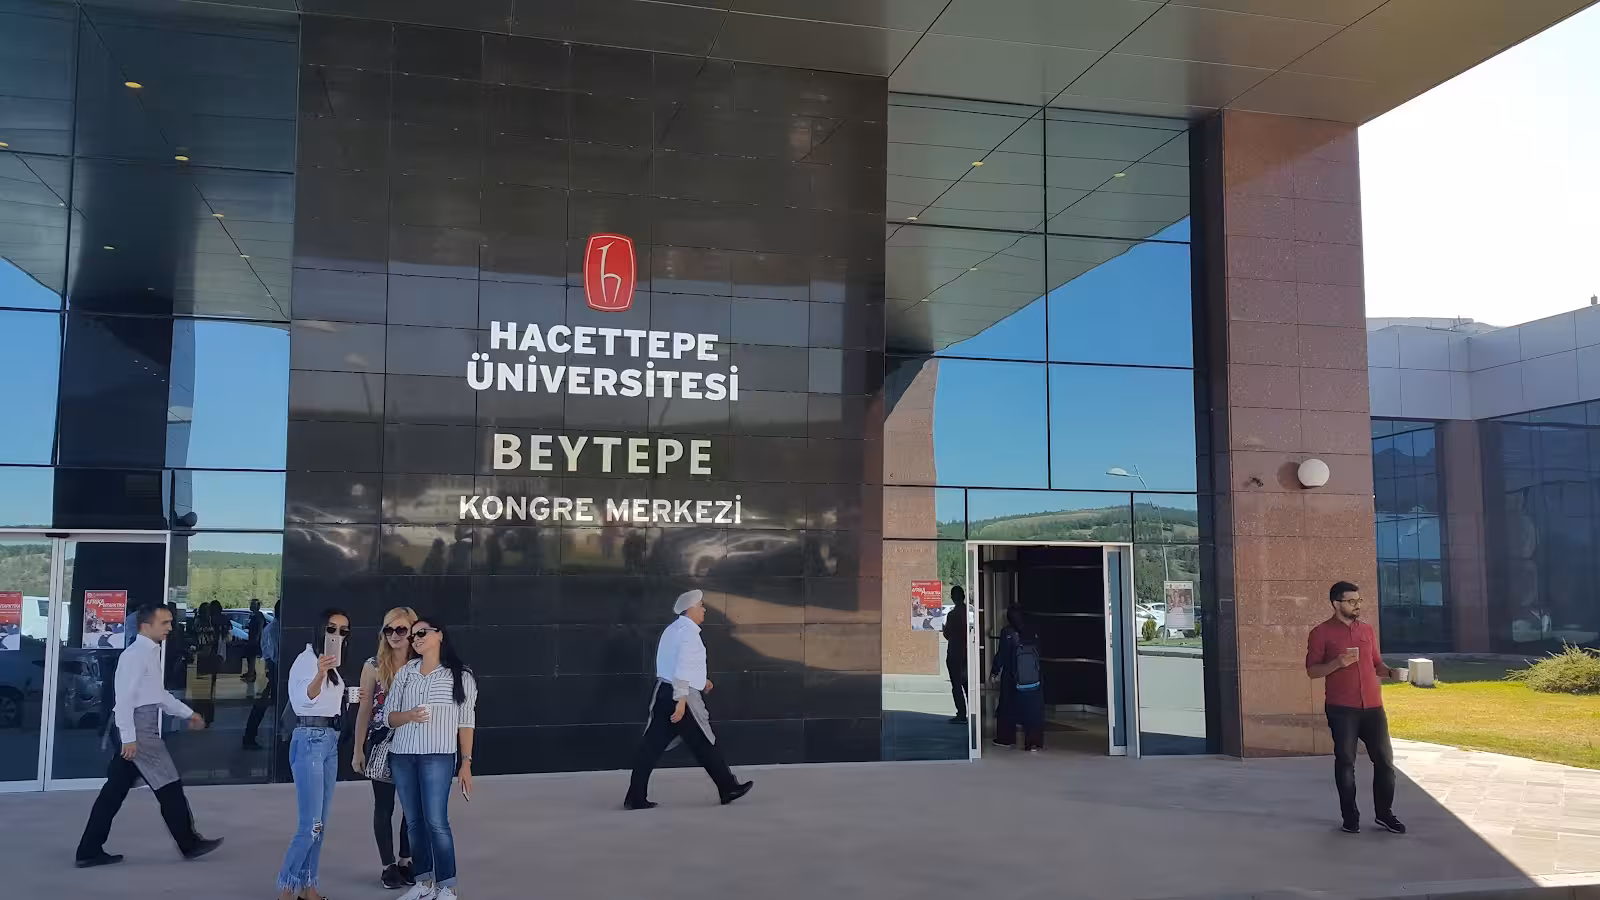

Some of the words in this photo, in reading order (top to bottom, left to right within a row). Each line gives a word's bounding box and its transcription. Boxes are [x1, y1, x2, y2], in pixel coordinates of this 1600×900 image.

[490, 320, 719, 362] HACETTEPE
[466, 352, 739, 401] ÜNİVERSİTESİ
[493, 433, 712, 475] BEYTEPE
[459, 495, 594, 522] KONGRE
[606, 494, 742, 524] MERKEZİ
